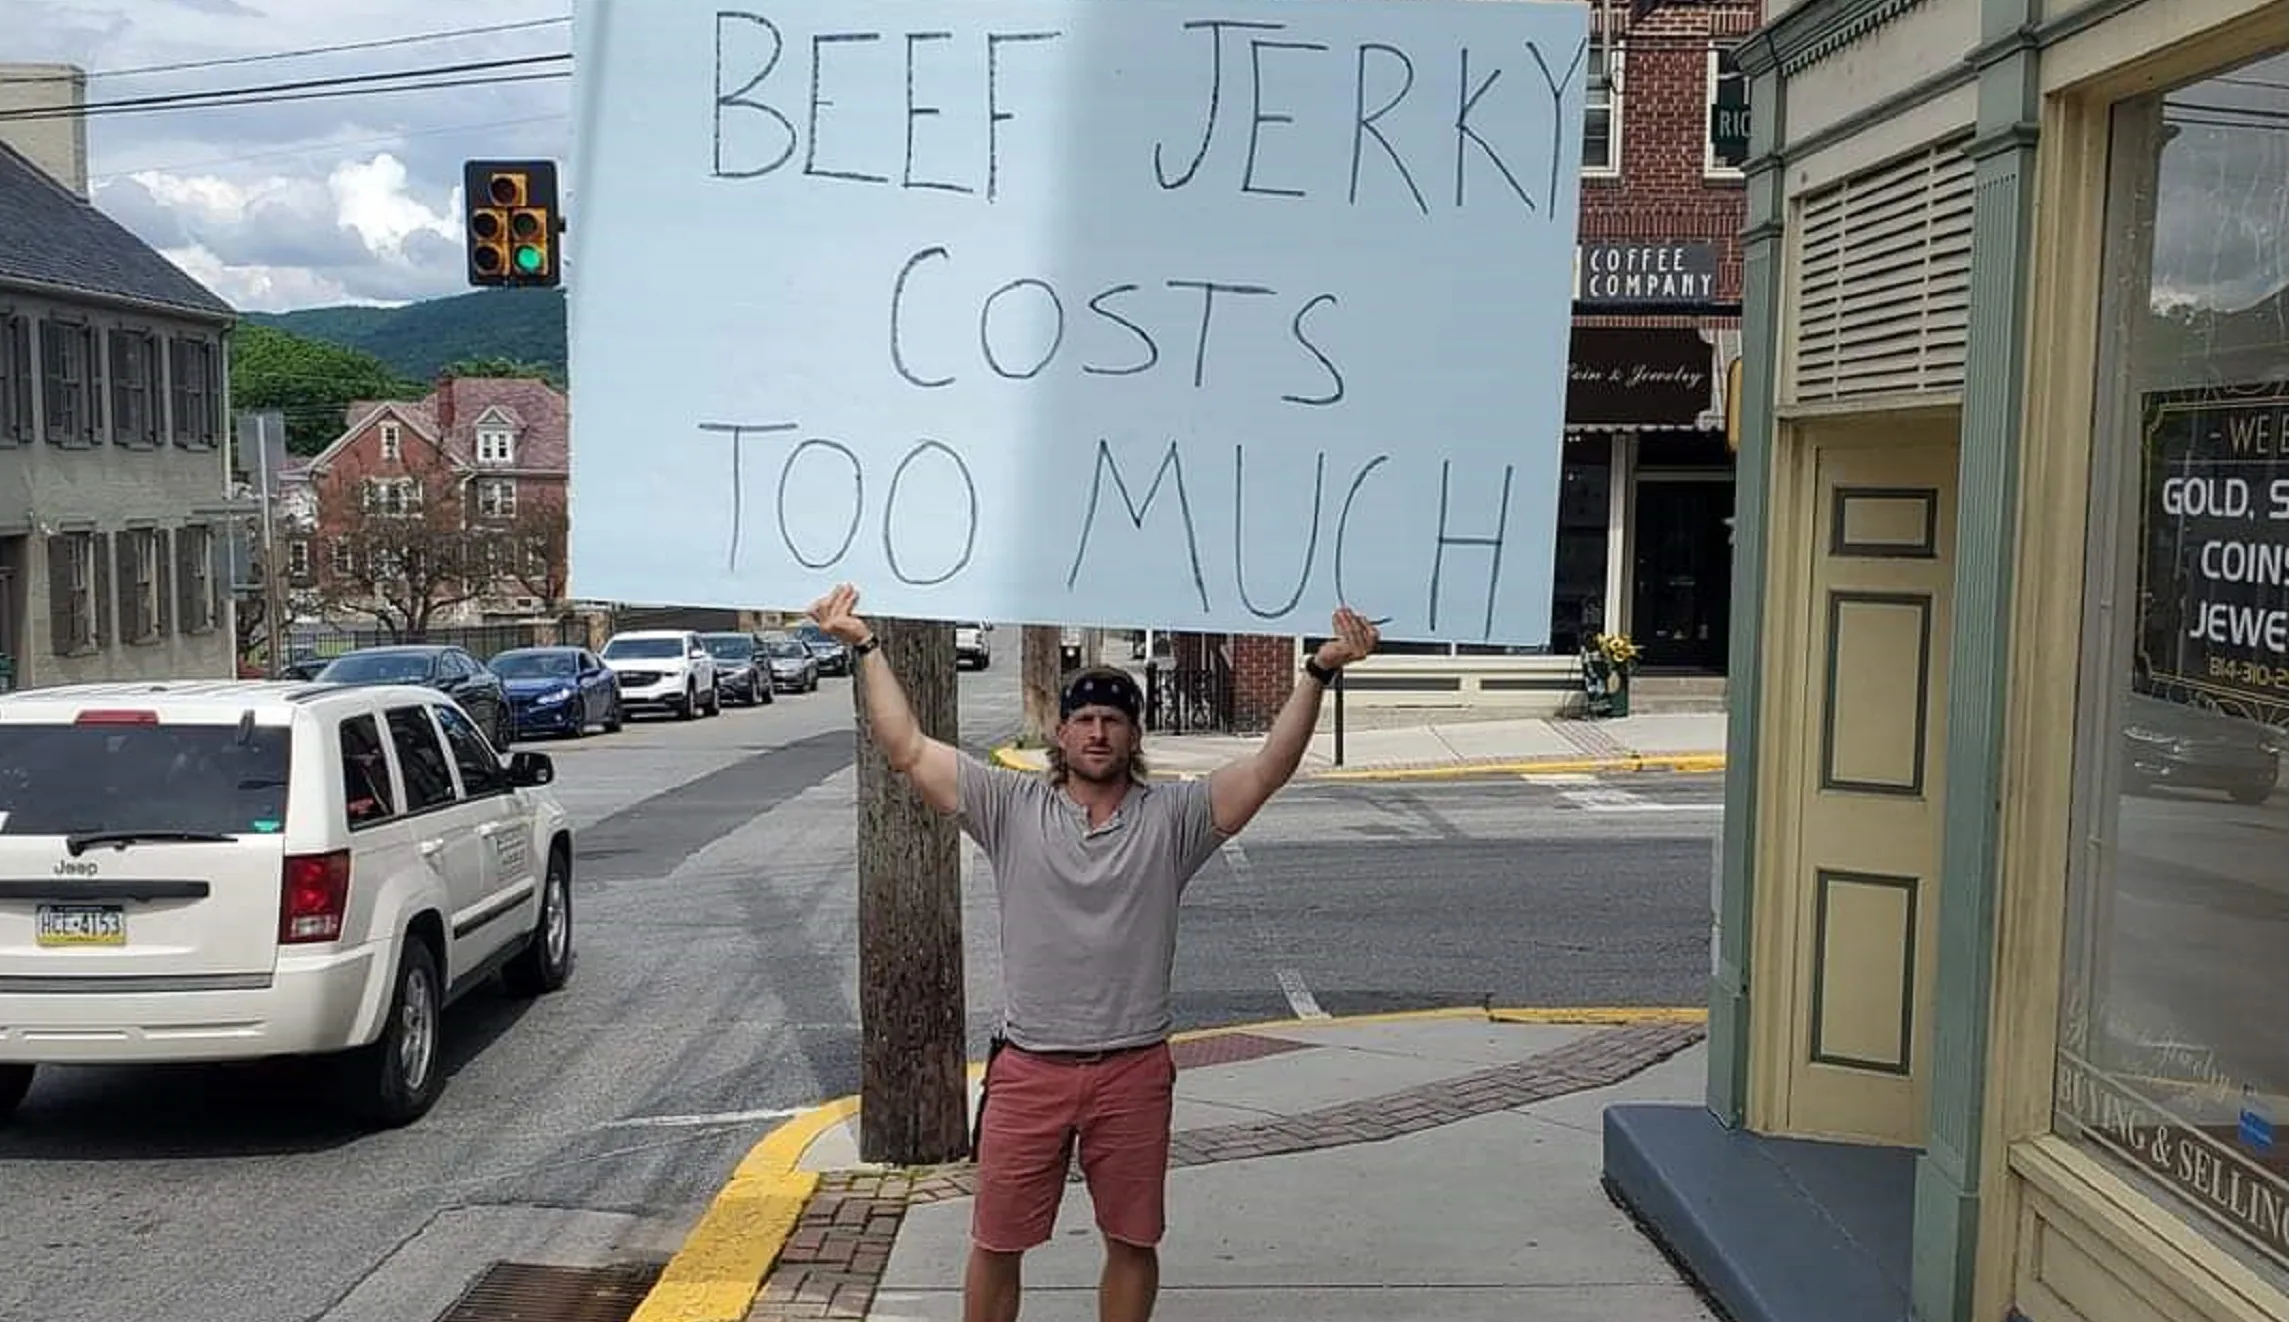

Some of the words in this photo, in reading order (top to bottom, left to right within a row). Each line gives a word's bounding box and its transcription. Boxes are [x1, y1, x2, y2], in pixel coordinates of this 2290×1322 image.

[711, 11, 1062, 204] BEEF
[1154, 20, 1587, 221] JERKY
[1589, 248, 1685, 273] COFFEE
[1589, 274, 1712, 298] COMPANY
[891, 246, 1344, 405] COSTS
[1624, 363, 1706, 390] Jewelry
[2228, 414, 2270, 454] WE
[698, 422, 978, 585] TOO
[1067, 438, 1514, 640] MUCH
[2201, 540, 2289, 585] COIN
[2188, 601, 2288, 653] JEWE
[54, 859, 98, 876] Jeep
[2151, 1125, 2172, 1169] &
